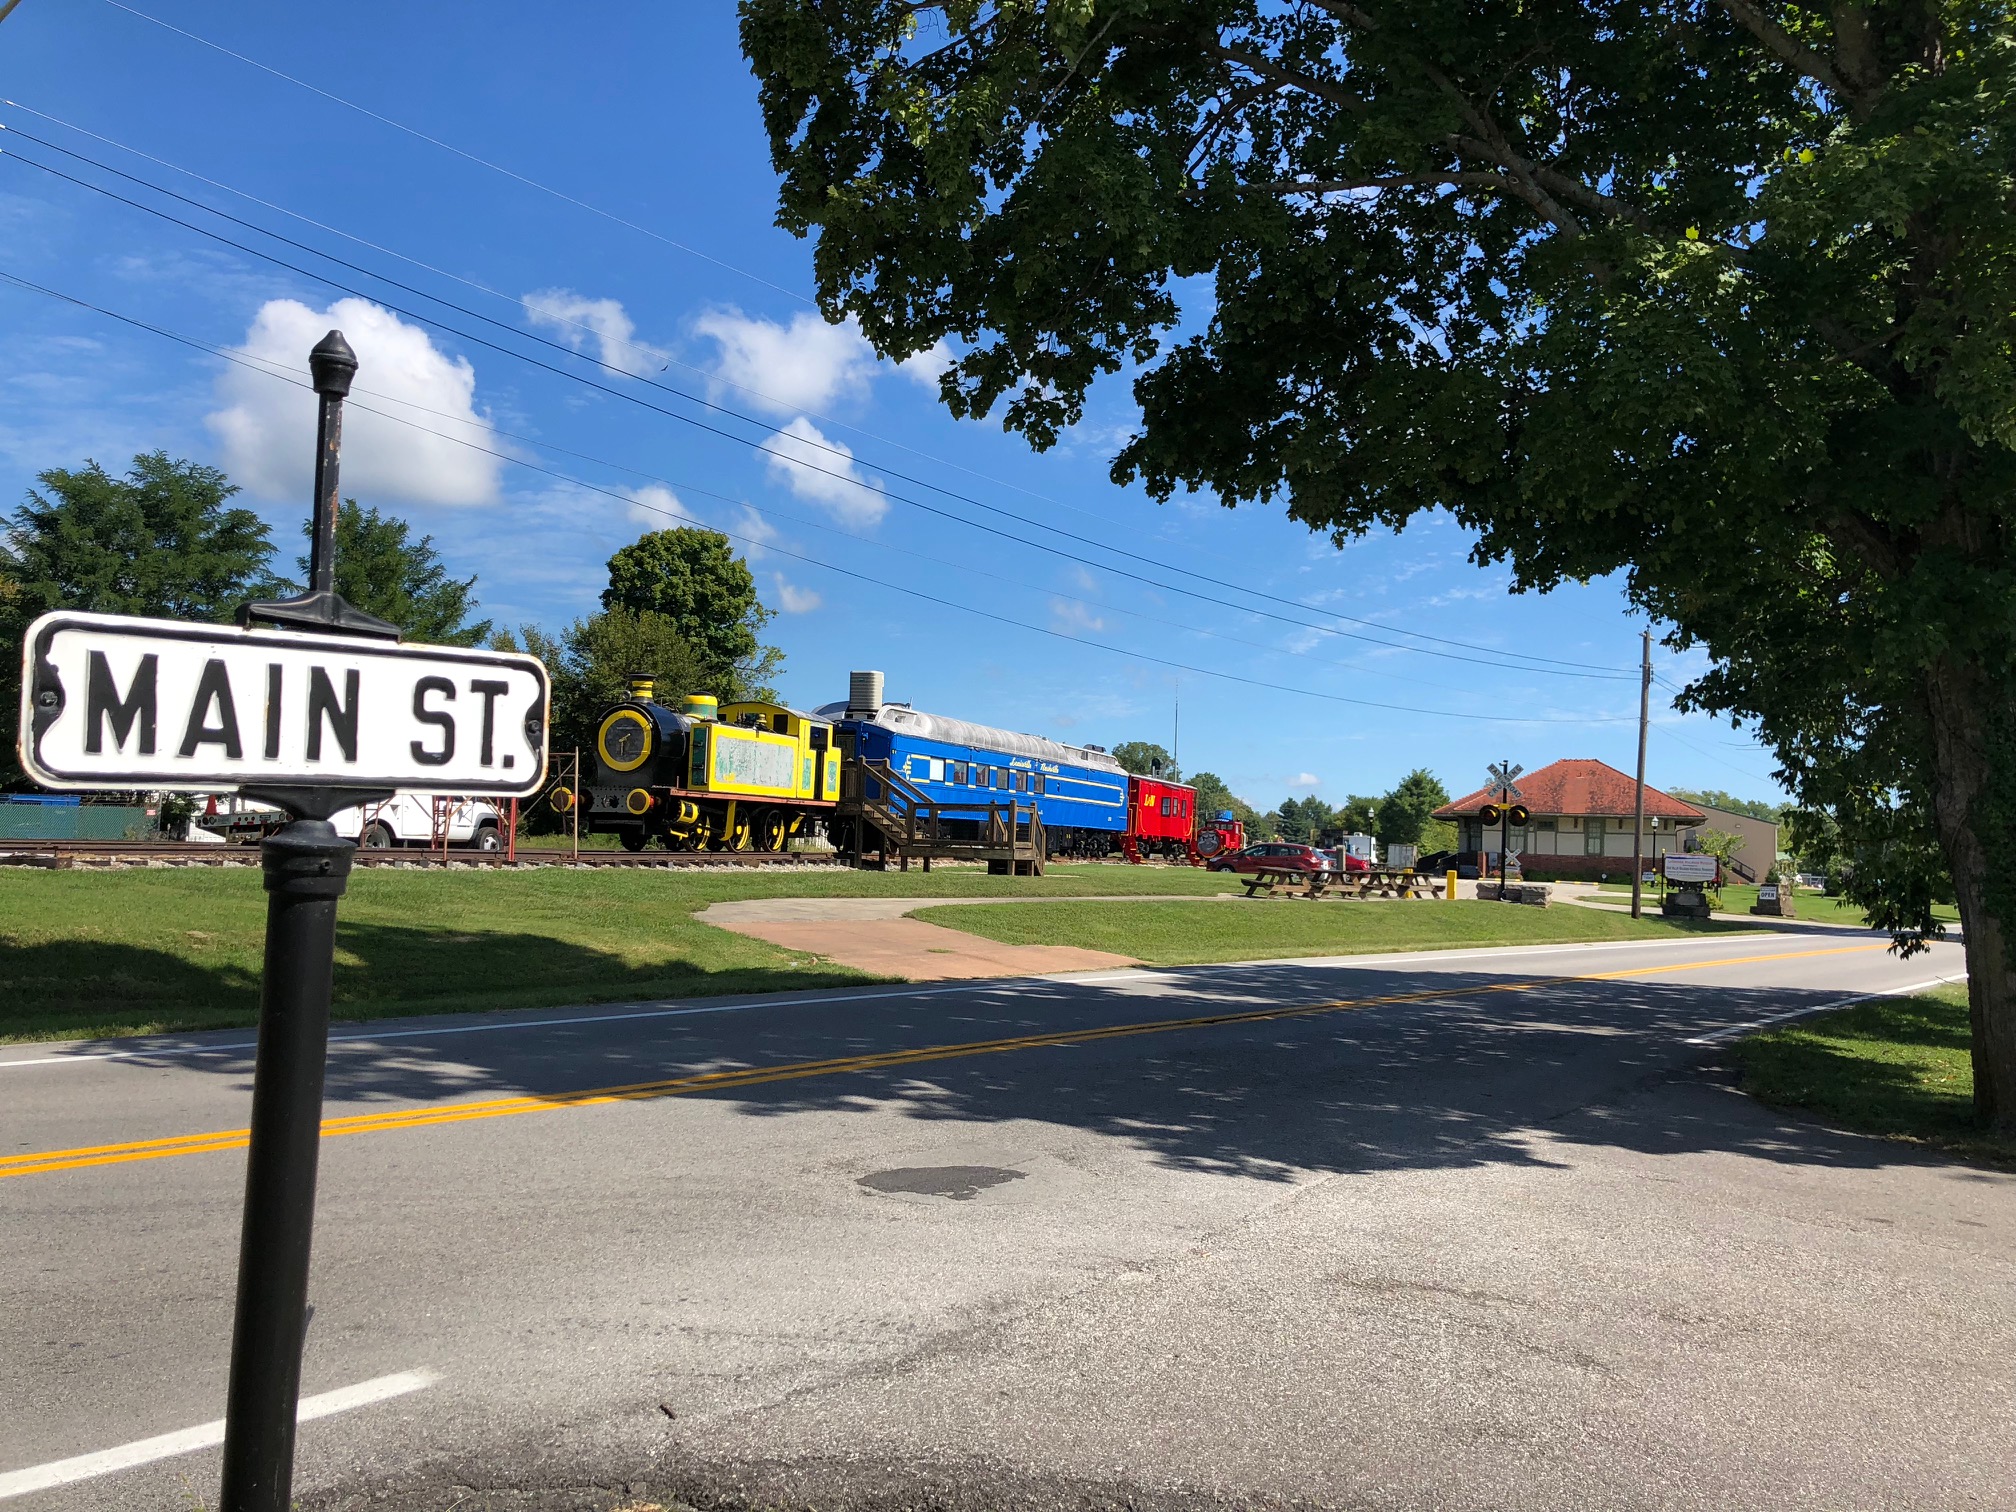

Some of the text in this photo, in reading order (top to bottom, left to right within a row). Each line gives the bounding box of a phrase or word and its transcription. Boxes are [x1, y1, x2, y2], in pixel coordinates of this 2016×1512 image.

[84, 650, 515, 769] MAIN ST.
[1487, 765, 1522, 798] CROSSING
